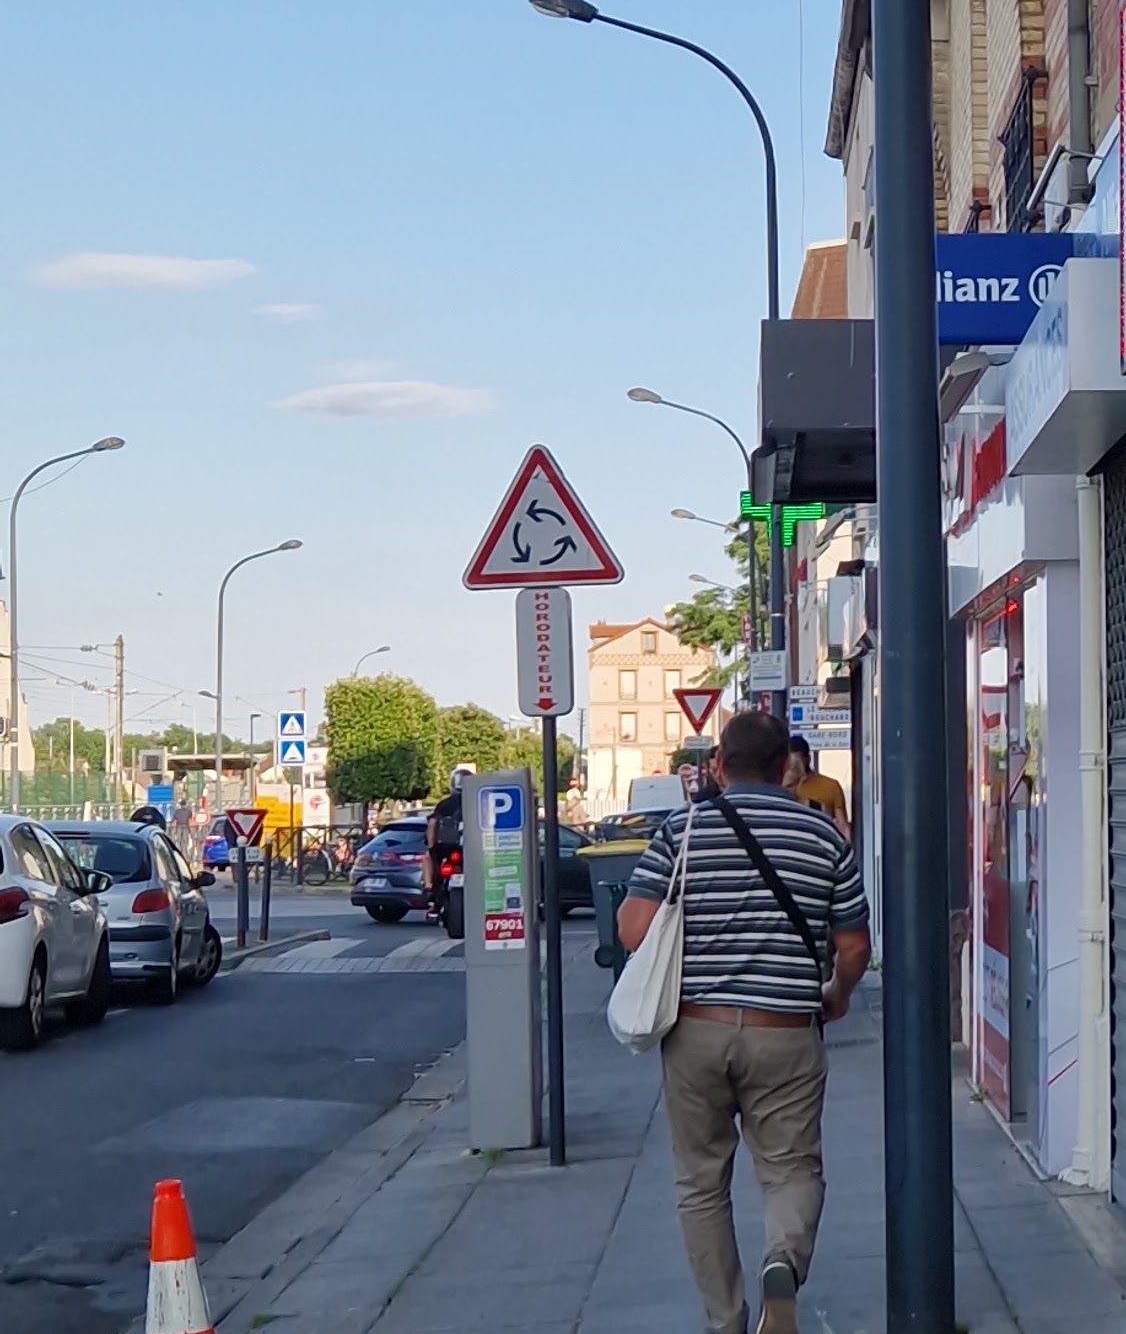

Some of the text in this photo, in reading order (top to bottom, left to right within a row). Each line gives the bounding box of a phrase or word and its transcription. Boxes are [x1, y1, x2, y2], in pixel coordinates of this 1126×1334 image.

[936, 270, 1021, 303] lianz
[534, 592, 553, 694] HORODATEUR
[488, 791, 513, 827] P
